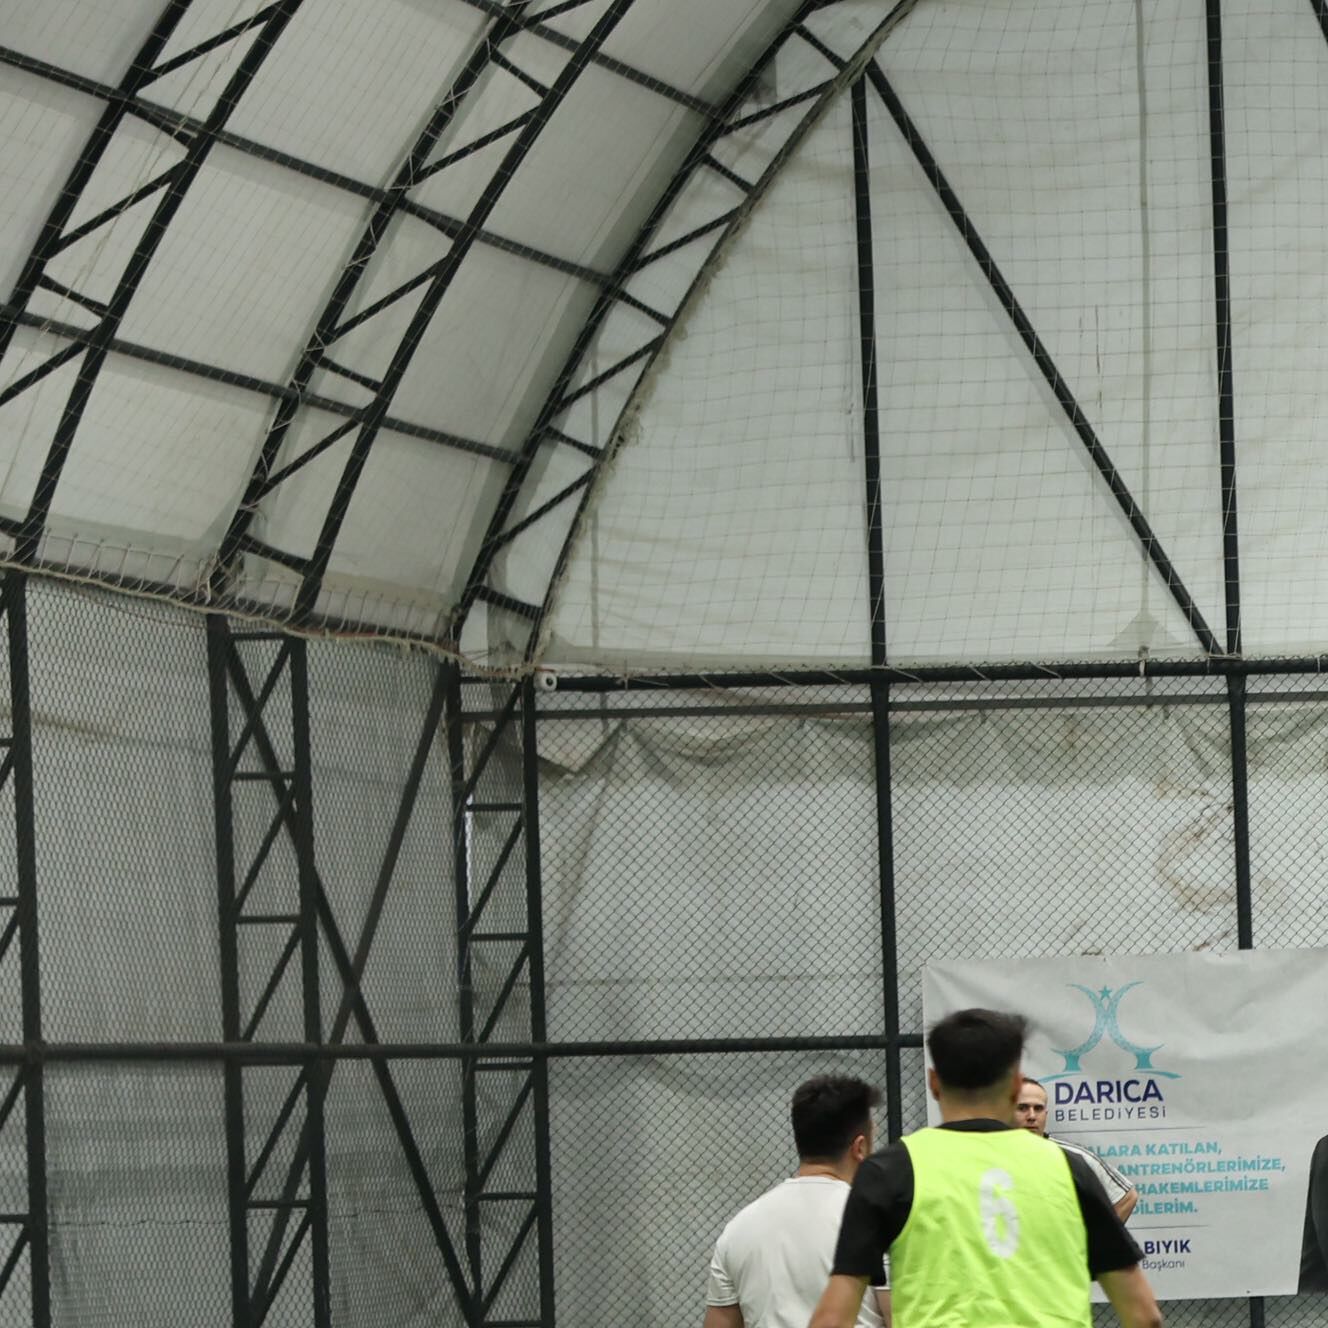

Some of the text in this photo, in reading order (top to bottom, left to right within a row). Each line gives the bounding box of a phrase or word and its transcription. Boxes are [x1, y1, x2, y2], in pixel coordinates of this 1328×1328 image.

[1055, 1079, 1164, 1105] DARICA
[1085, 1141, 1222, 1157] ALARA KATILAN,
[1135, 1176, 1269, 1195] HAKEMLERİMİZE
[979, 1167, 1021, 1260] 6
[1144, 1239, 1192, 1255] BIYIK
[1142, 1259, 1185, 1272] Başkanı
